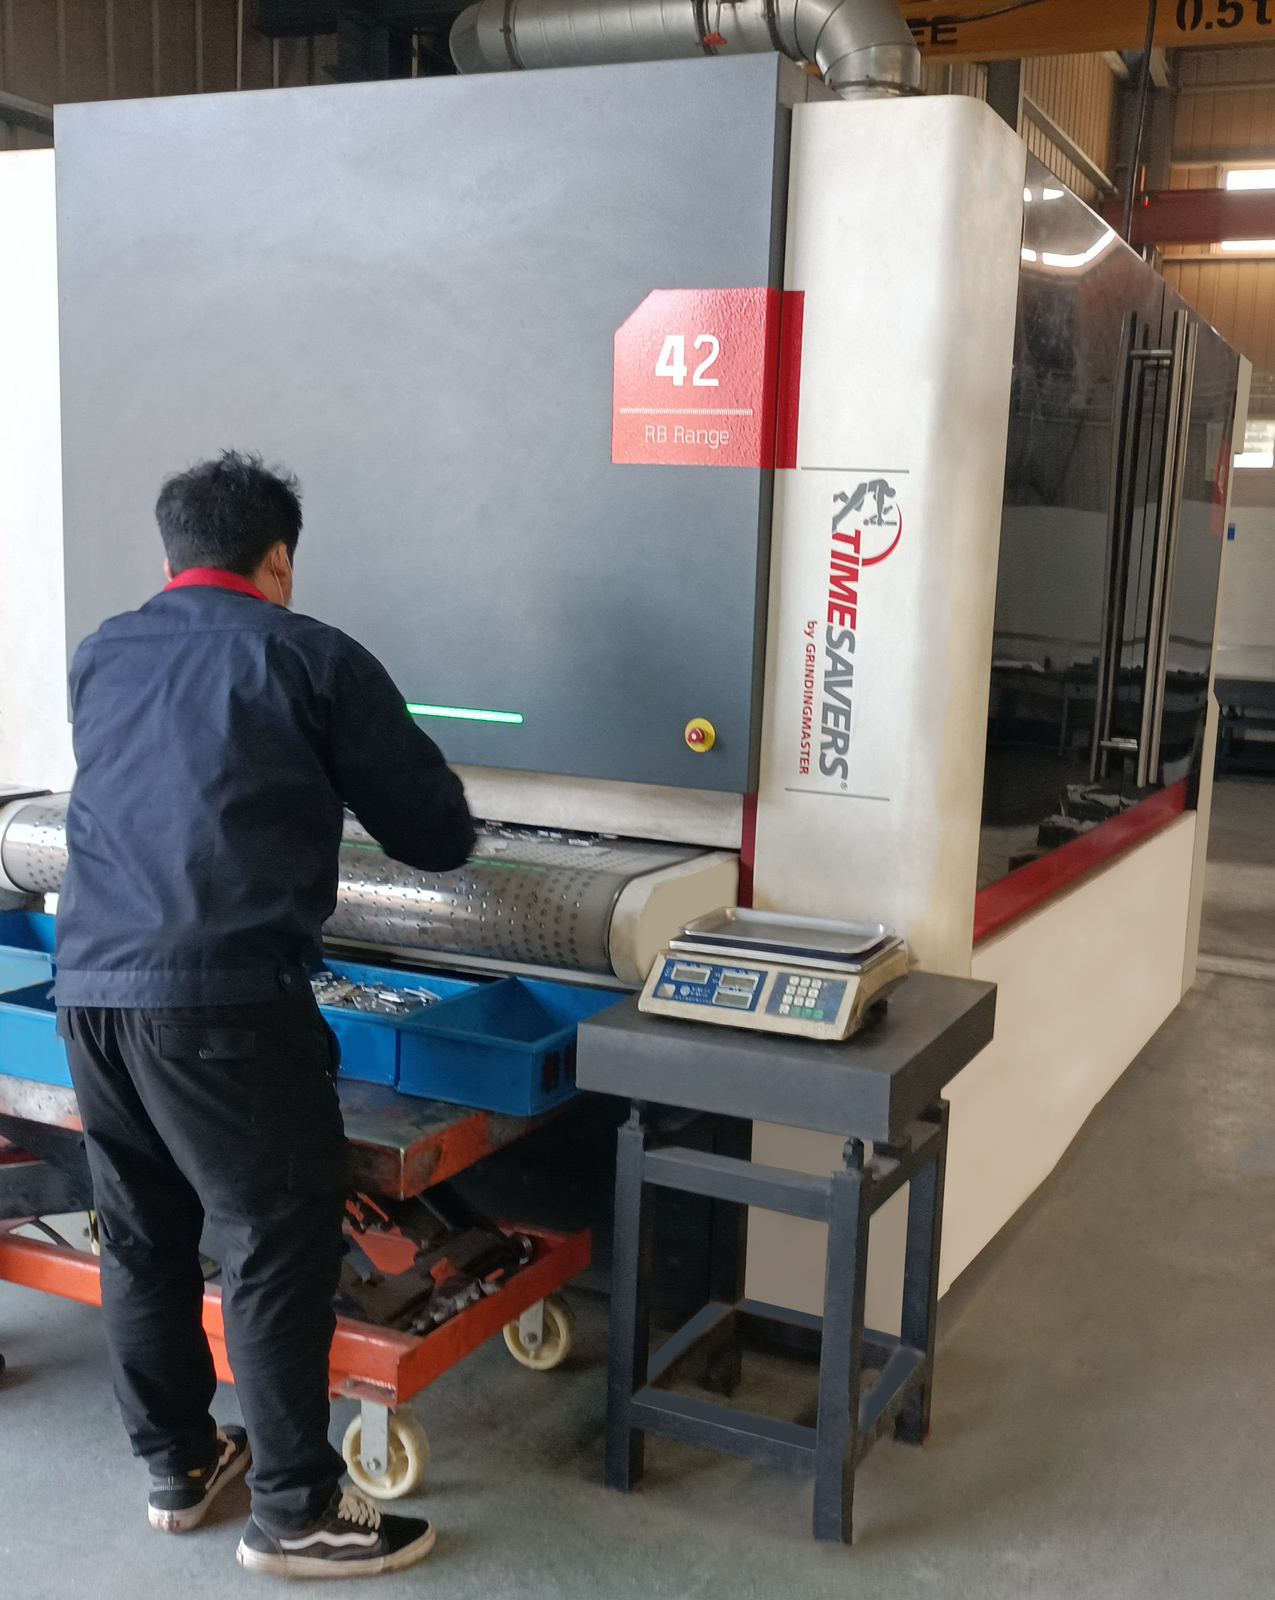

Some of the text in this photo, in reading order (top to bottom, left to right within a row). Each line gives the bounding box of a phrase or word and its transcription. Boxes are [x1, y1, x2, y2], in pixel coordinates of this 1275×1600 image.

[655, 334, 720, 386] 42
[645, 425, 729, 449] RB Range
[799, 621, 818, 775] by GRINDINGMASTER
[819, 529, 861, 780] TIMESAVERS
